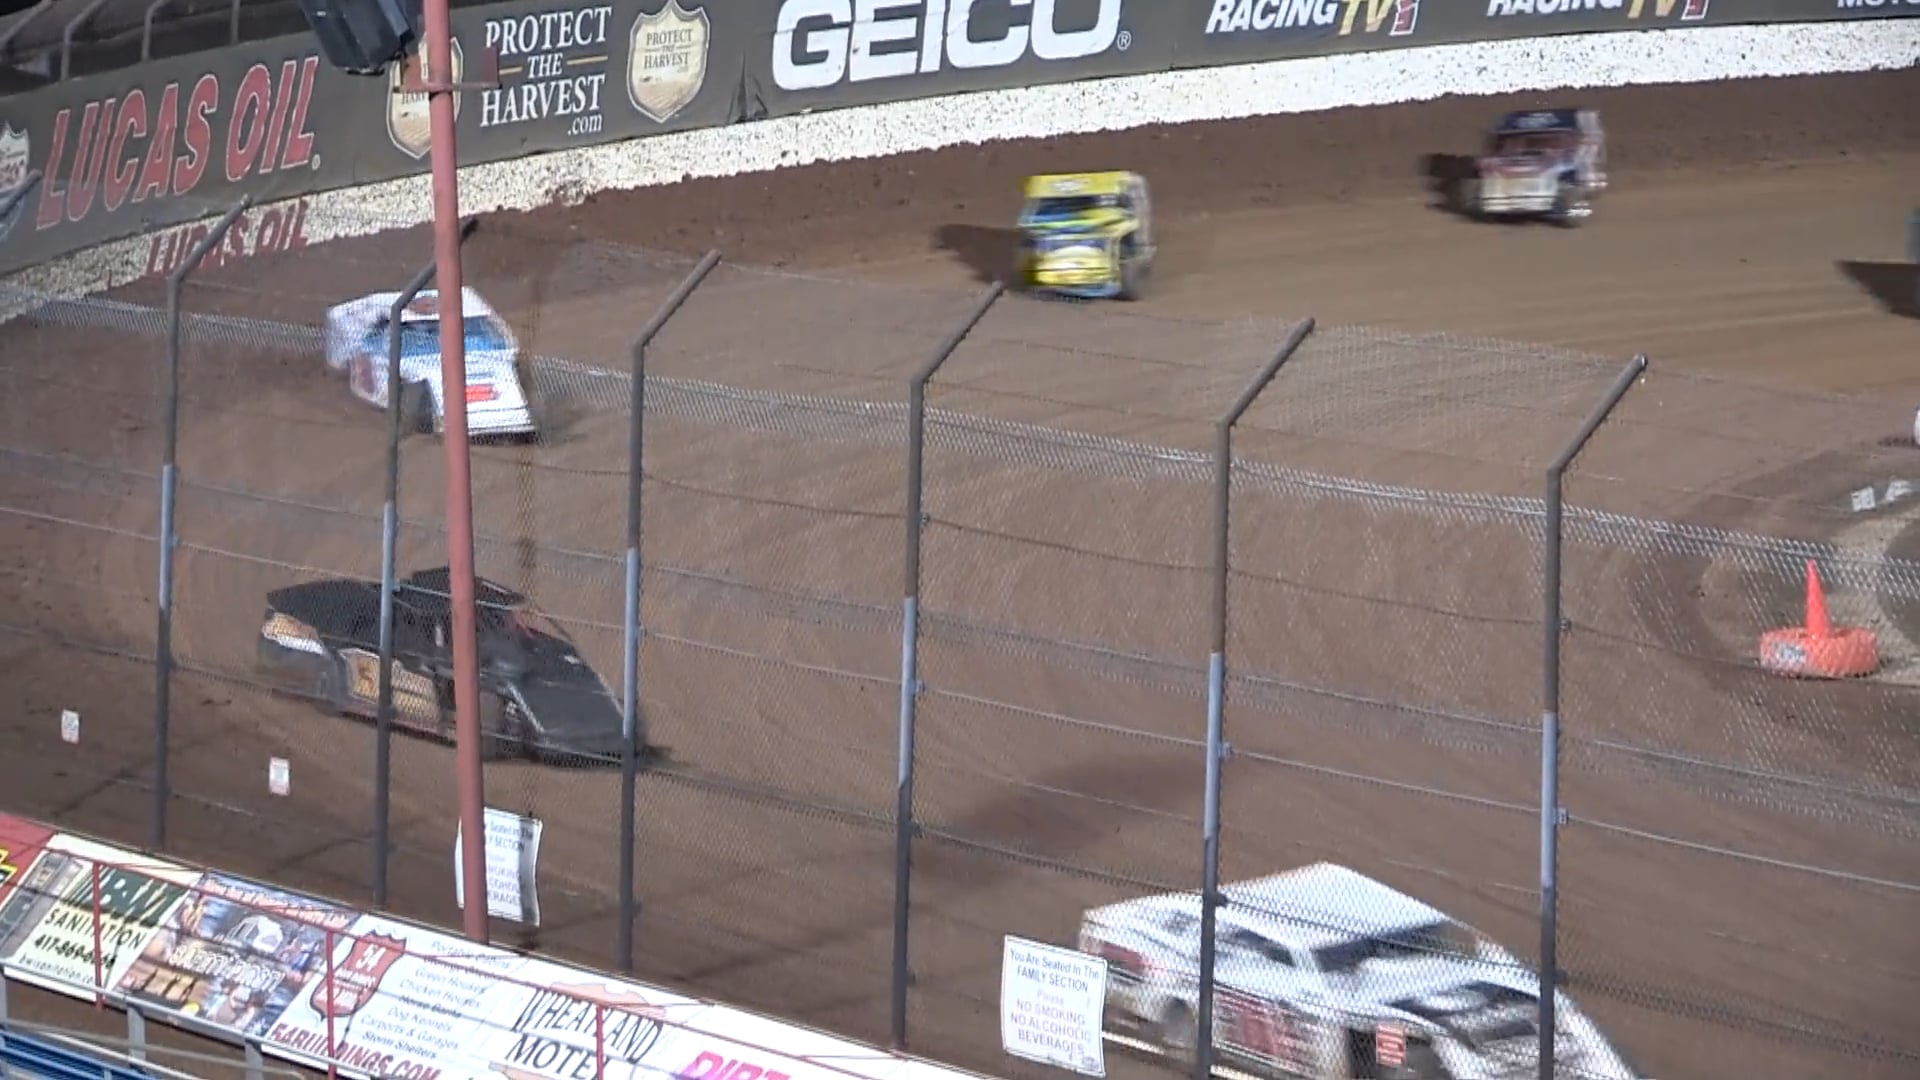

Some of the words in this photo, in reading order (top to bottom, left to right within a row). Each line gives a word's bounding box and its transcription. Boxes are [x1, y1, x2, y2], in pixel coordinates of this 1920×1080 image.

[485, 6, 612, 55] PROTECT
[646, 28, 693, 46] PROTECT
[772, 0, 1122, 91] GEICO
[527, 52, 563, 79] THE
[644, 51, 690, 69] HARVEST
[480, 74, 605, 127] HARVEST
[567, 114, 602, 135] .com
[36, 73, 219, 231] LUCAS
[226, 55, 320, 182] OIL
[355, 943, 386, 972] 54
[1010, 948, 1025, 962] You
[1026, 953, 1040, 966] Are
[1041, 957, 1071, 973] Seated
[1083, 965, 1100, 980] The
[1017, 965, 1046, 983] FAMILY
[1048, 974, 1089, 992] SECTION
[1016, 999, 1032, 1012] NO
[1034, 1003, 1086, 1026] SMOKING
[1010, 1012, 1026, 1025] NO
[1028, 1016, 1092, 1042] ALCOHOLIC
[1018, 1029, 1085, 1055] BEVERAGES
